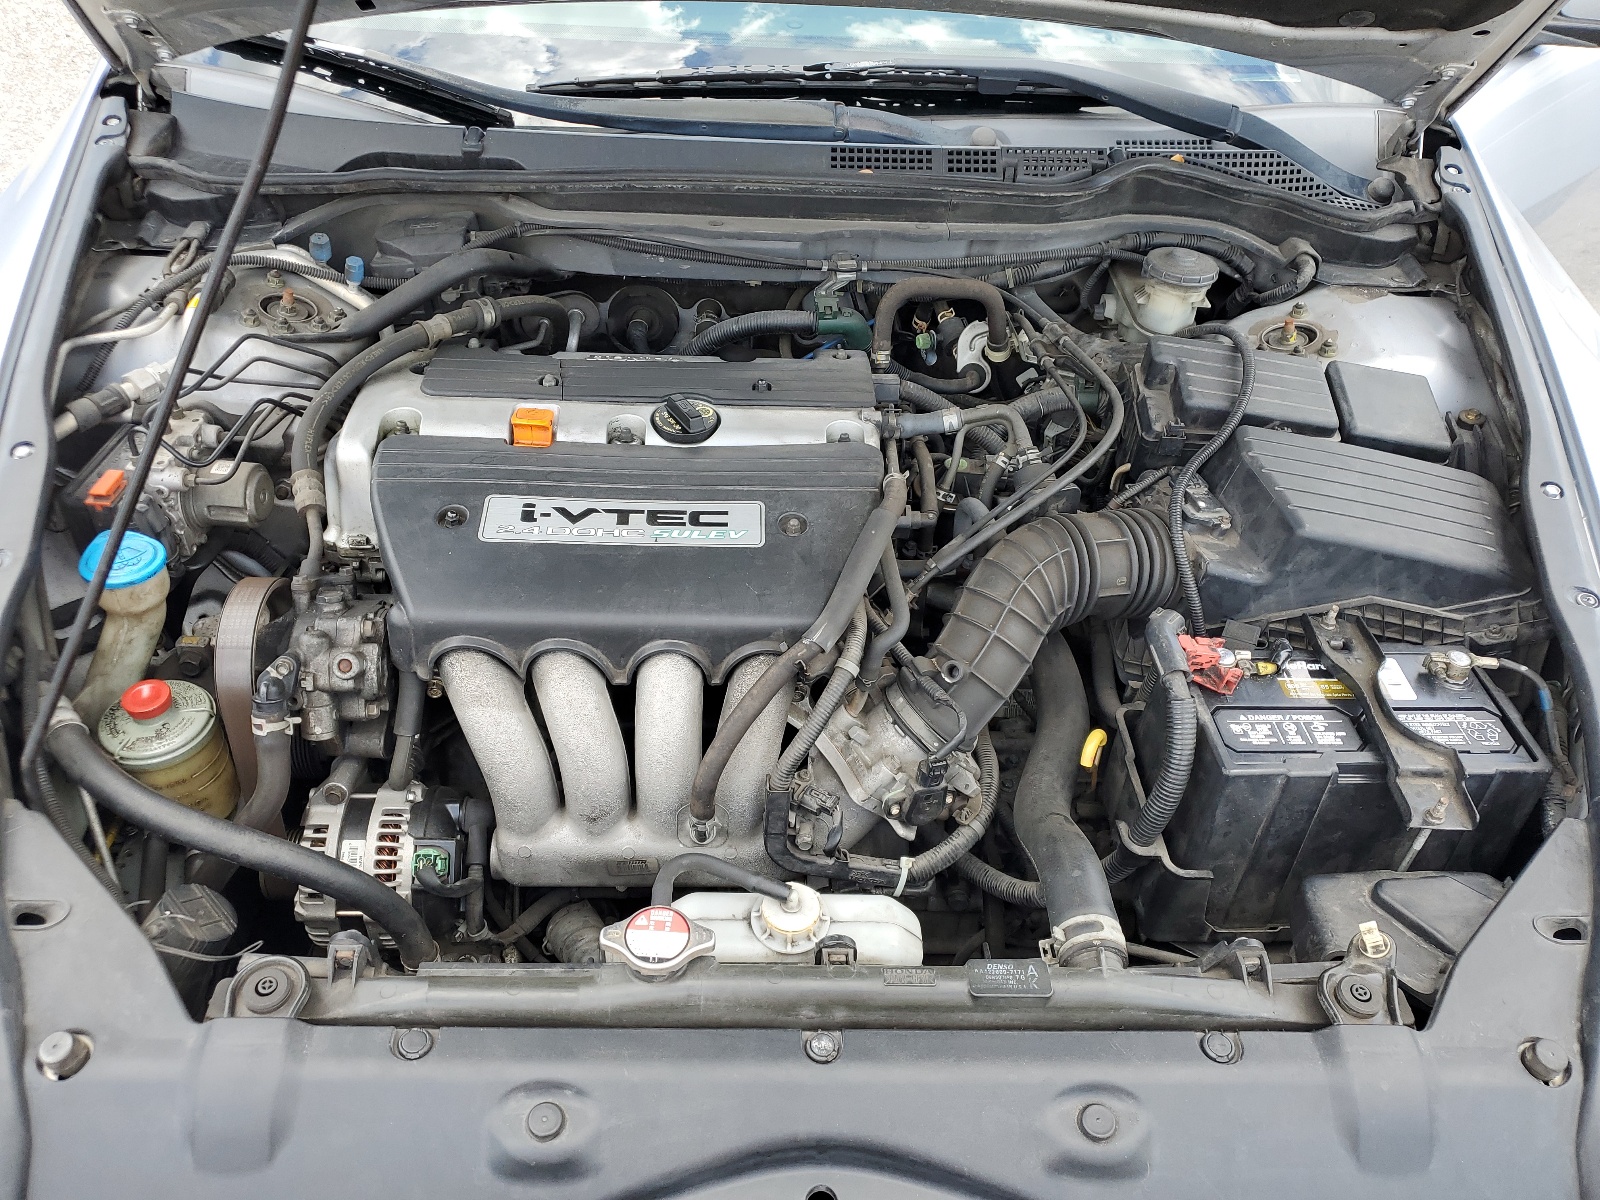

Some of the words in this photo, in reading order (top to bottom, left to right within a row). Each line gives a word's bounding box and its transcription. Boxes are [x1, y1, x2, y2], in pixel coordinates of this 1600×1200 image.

[520, 502, 729, 527] i-VTEC
[650, 529, 749, 539] SULEV
[650, 909, 674, 917] DANGER
[1027, 964, 1039, 977] A
[1028, 976, 1040, 989] K
